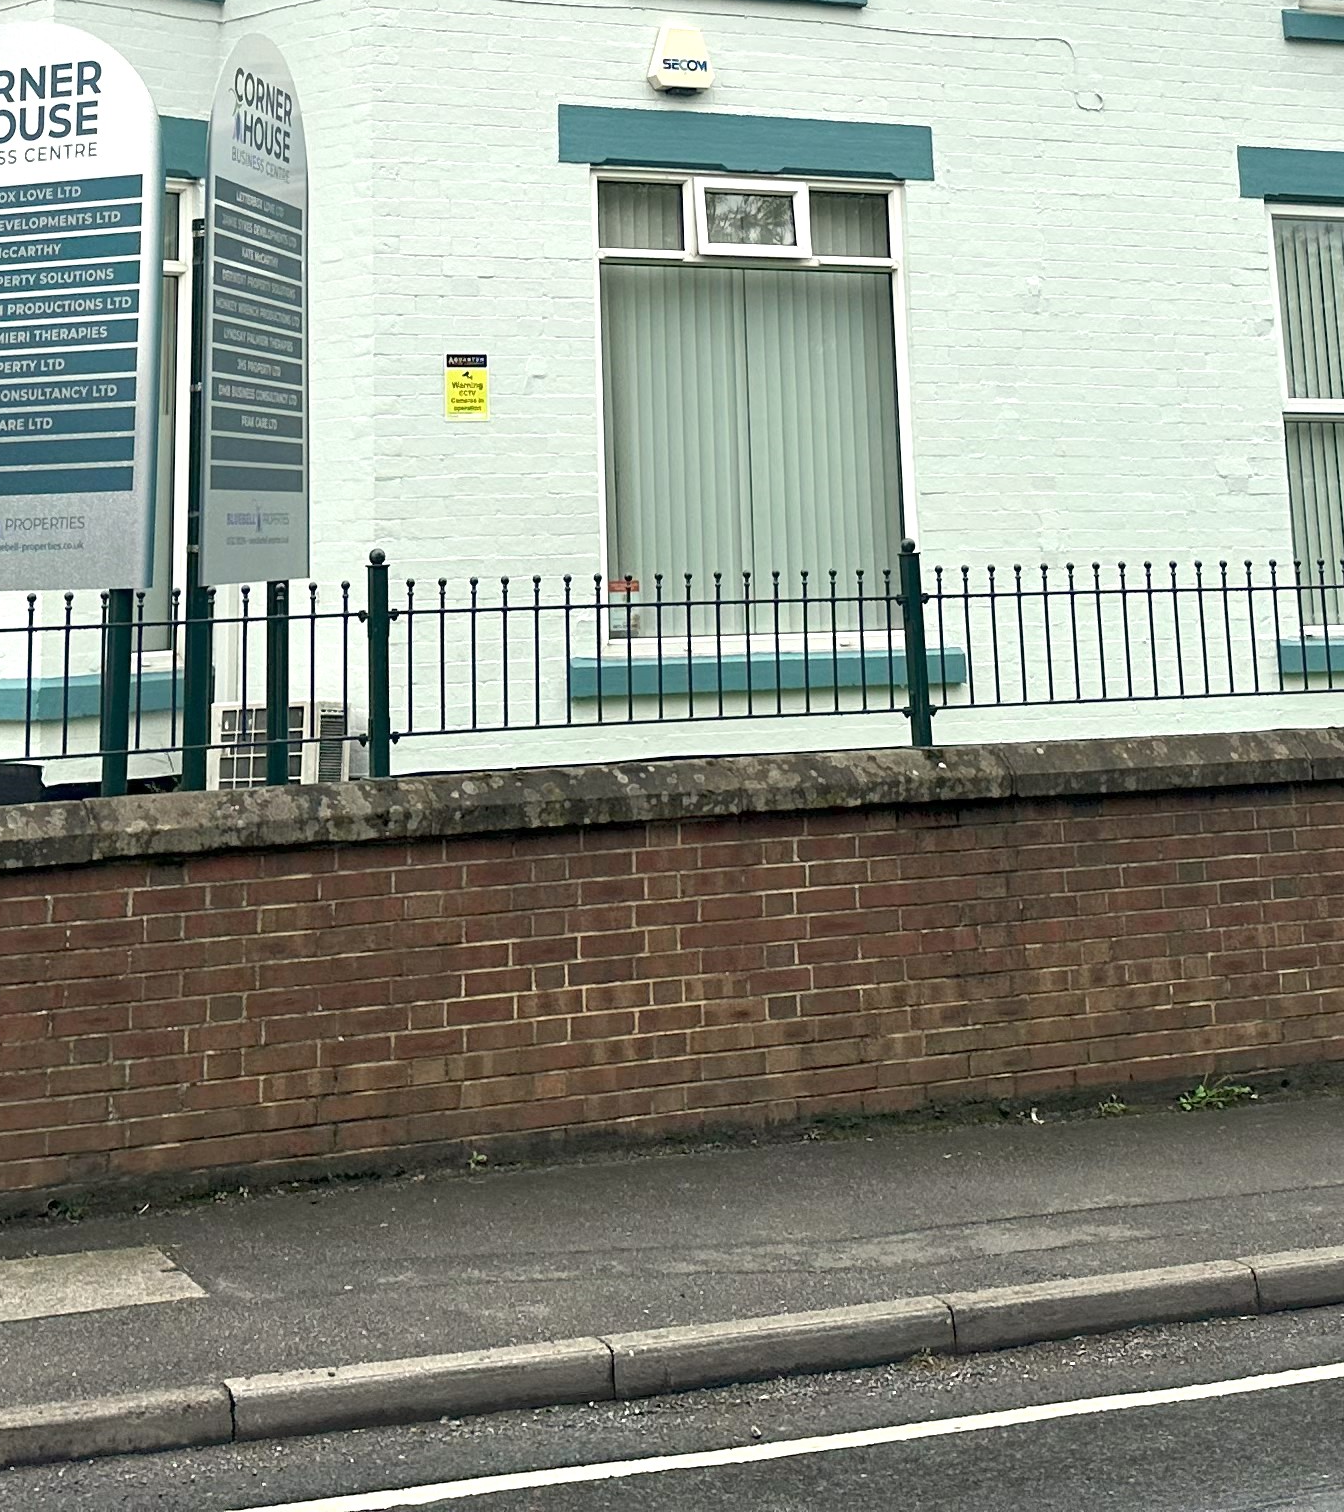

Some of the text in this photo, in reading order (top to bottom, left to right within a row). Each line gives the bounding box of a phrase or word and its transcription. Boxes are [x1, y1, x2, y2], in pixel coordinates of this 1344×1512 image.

[663, 58, 707, 72] SECOM
[235, 67, 292, 127] CORNER
[244, 110, 290, 164] HOUSE
[24, 142, 98, 163] CENTRE
[232, 146, 290, 184] BUSINESS CENTRE
[19, 189, 53, 202] LOVE
[57, 186, 81, 199] LTD
[96, 211, 121, 224] LTD
[39, 268, 114, 284] SOLUTIONS
[7, 298, 103, 316] PRODUCTIONS
[107, 296, 132, 309] LTD
[34, 326, 108, 342] THERAPIES
[40, 358, 65, 371] LTD
[92, 384, 117, 397] LTD
[452, 382, 483, 390] Warning
[28, 417, 53, 430] LTD
[5, 516, 85, 531] PROPERTIES
